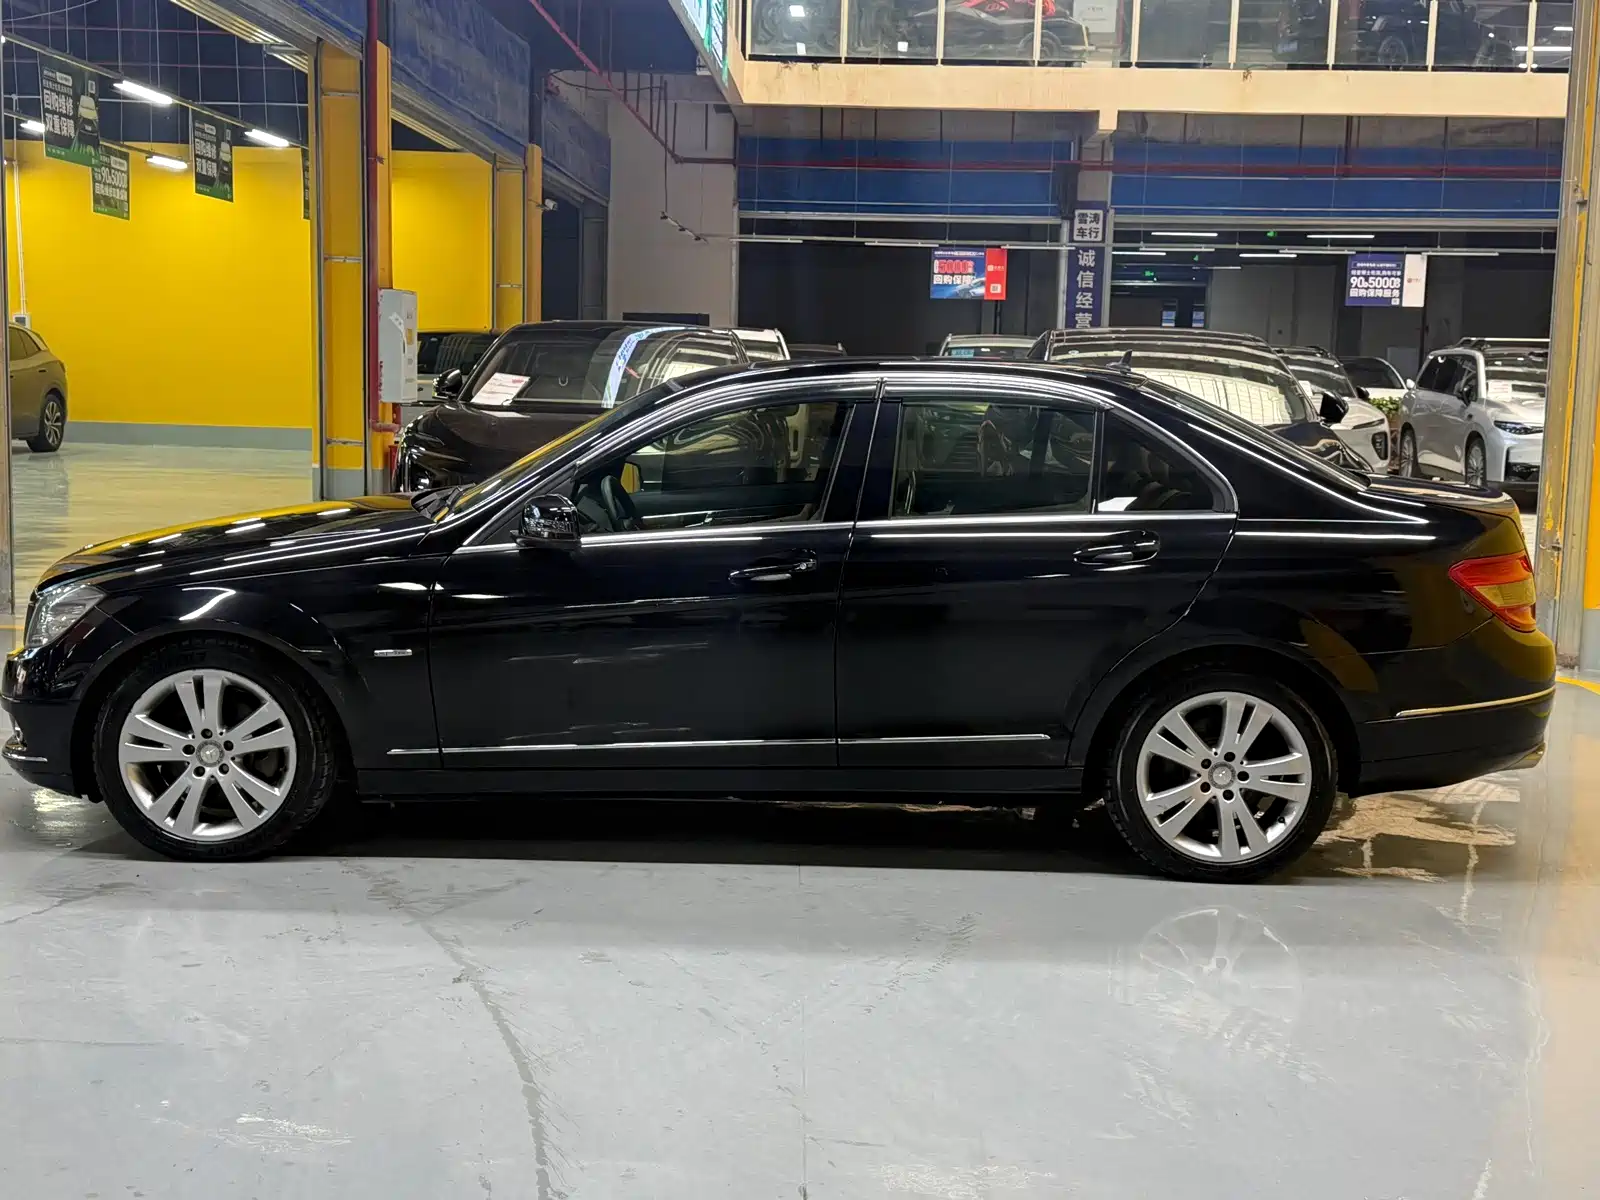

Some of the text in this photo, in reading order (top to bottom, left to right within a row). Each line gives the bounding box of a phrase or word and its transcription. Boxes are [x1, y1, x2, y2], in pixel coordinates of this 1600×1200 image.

[43, 88, 74, 116] 回购维修
[45, 112, 75, 139] 双重保障
[1077, 212, 1100, 225] 雪涛
[1076, 226, 1100, 239] 车行
[933, 274, 973, 285] 回购保障
[1075, 249, 1096, 329] 诚信经营
[1349, 288, 1400, 298] 回购保障服务
